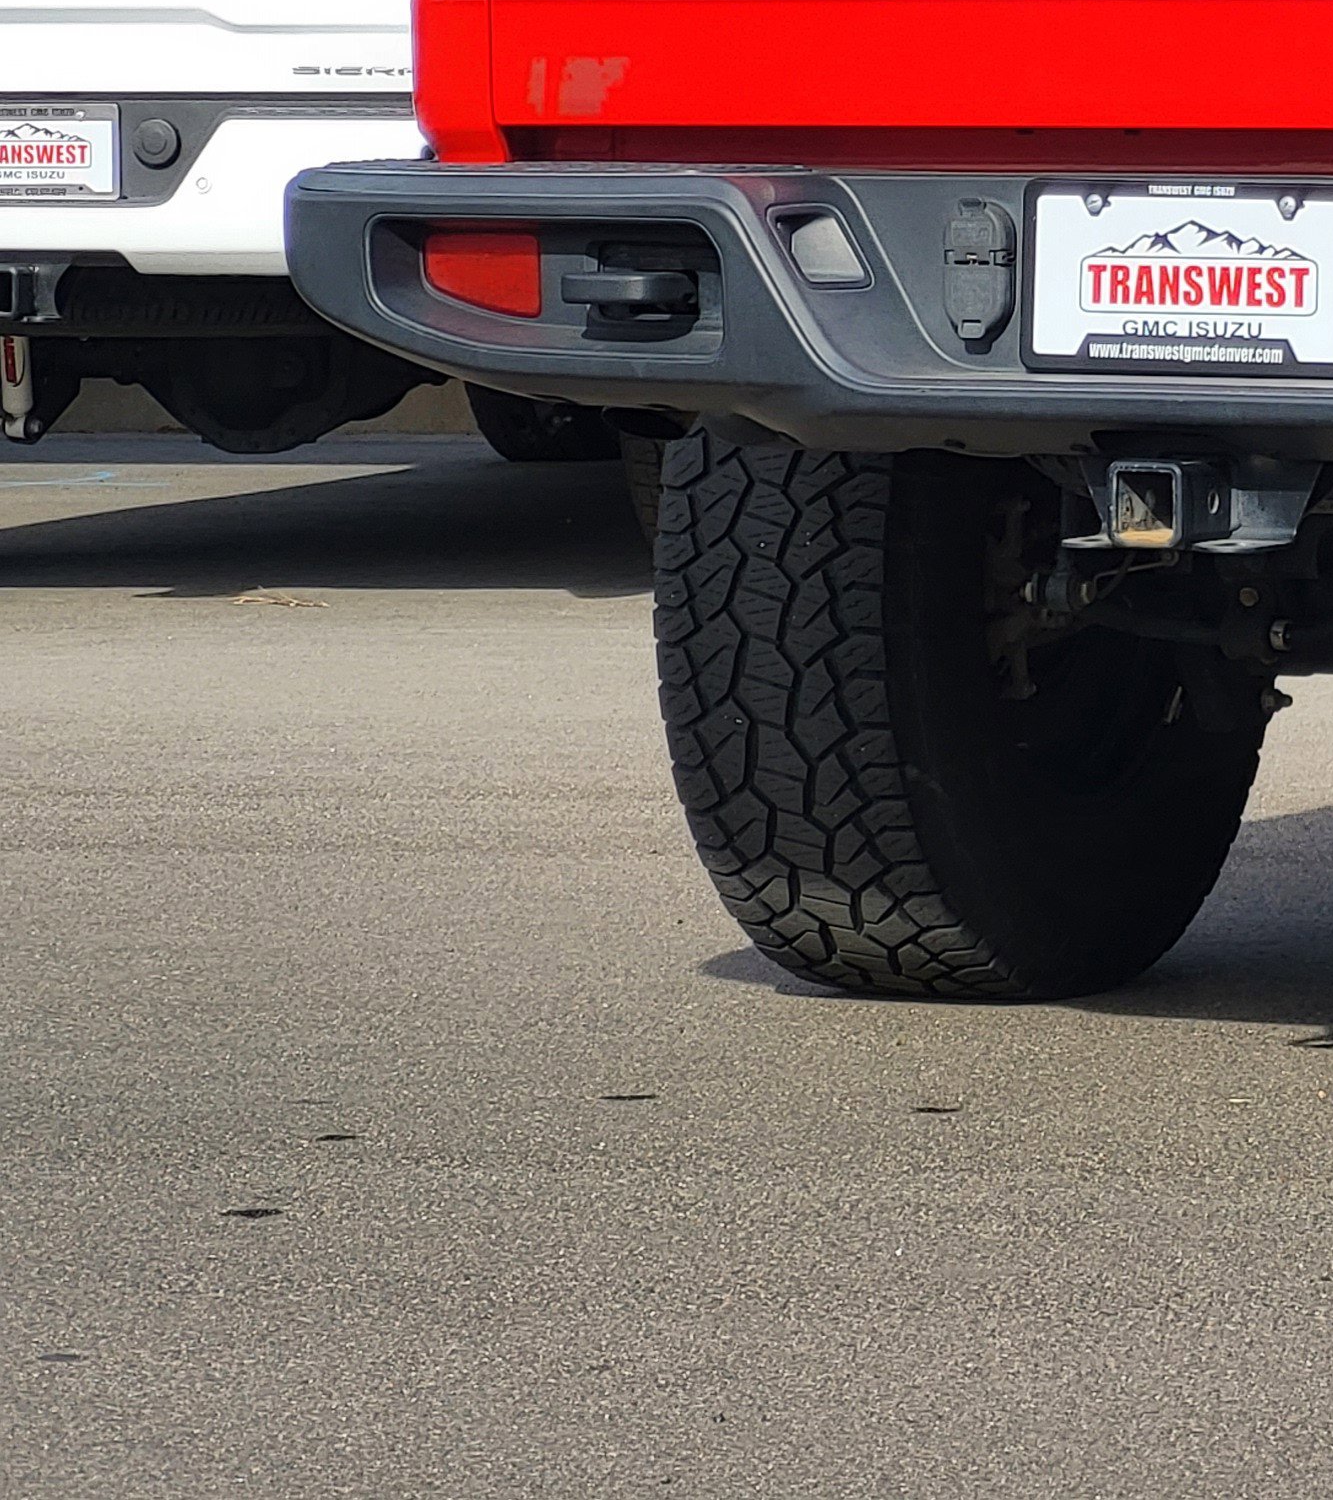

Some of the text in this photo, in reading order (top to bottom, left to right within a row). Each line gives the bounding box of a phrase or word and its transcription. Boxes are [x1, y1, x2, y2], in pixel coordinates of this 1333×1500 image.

[0, 170, 65, 179] MC ISUZU
[1087, 264, 1310, 308] TRANSWEST
[1121, 319, 1263, 339] GMC ISUZU
[1088, 341, 1284, 365] www.transwestgmcdenver.com
